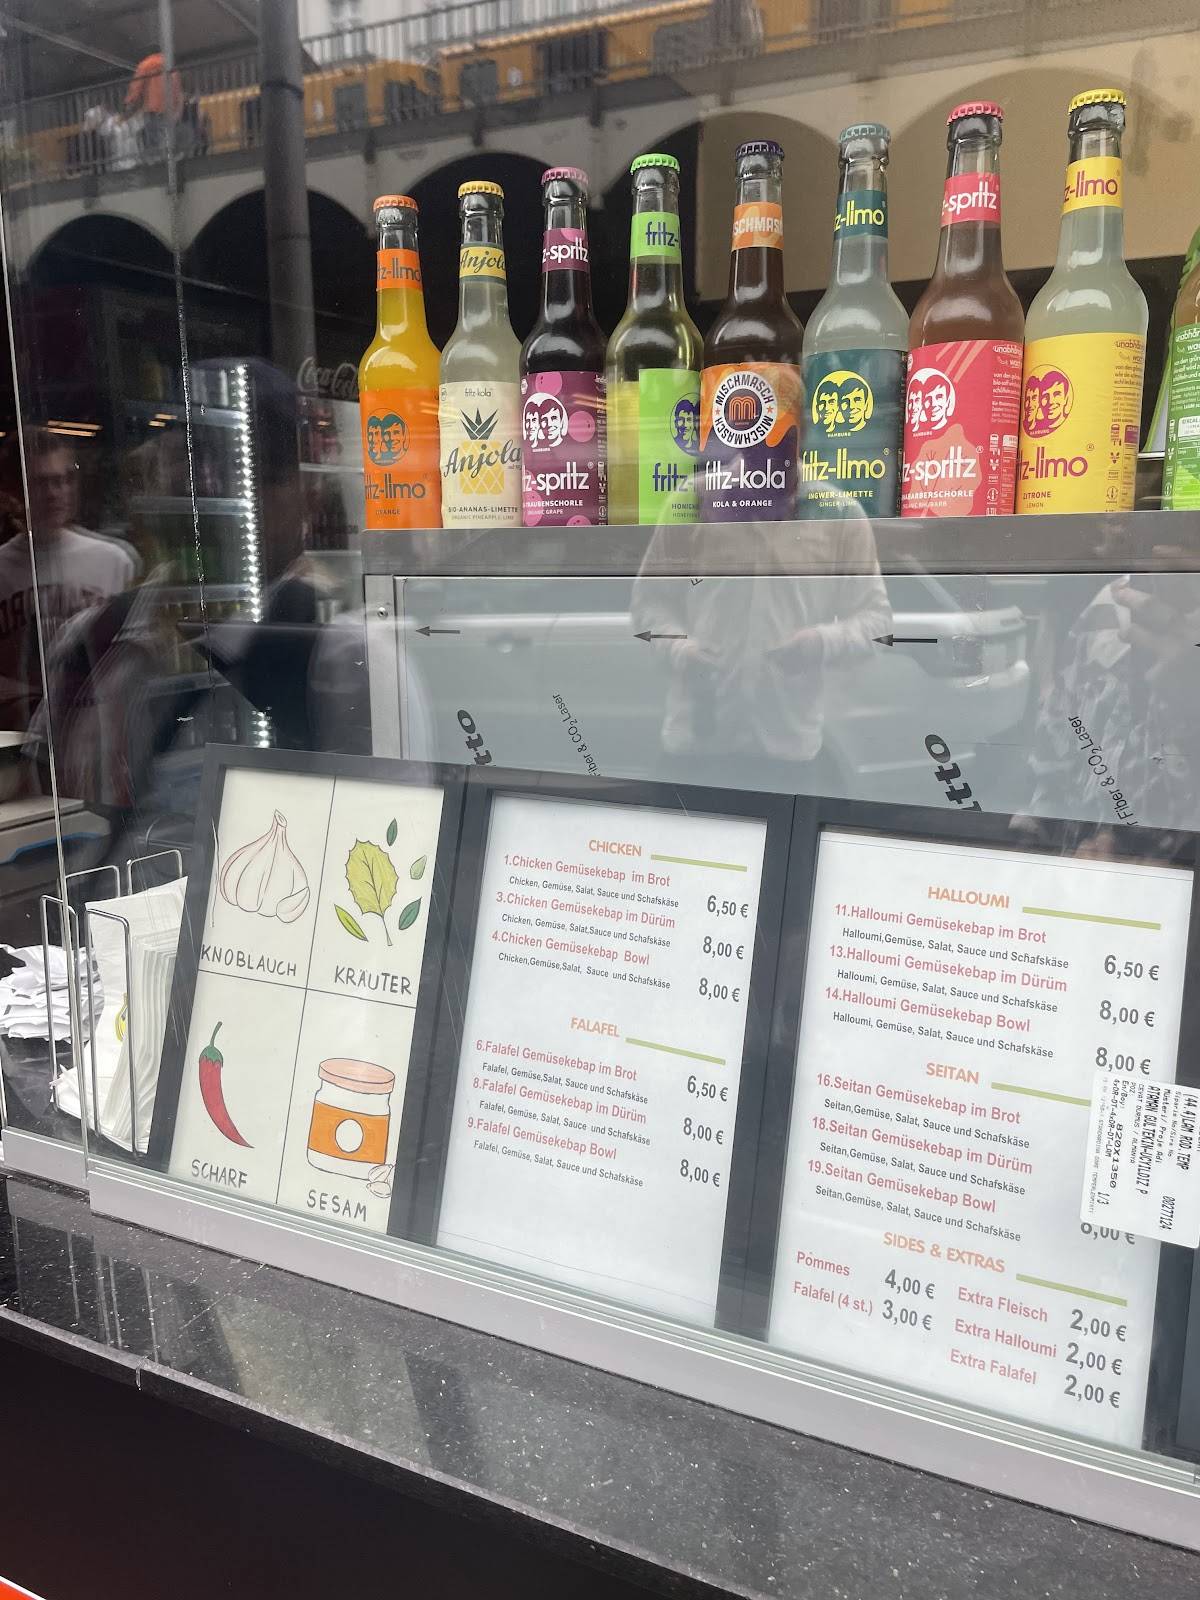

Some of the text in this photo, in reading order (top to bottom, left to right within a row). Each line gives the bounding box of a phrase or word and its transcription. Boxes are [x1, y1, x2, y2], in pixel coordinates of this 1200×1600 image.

[715, 372, 775, 407] MISCHMASCH
[715, 415, 774, 445] MISCHMASCH
[444, 439, 521, 478] Anjola
[705, 459, 786, 491] fritz-kola
[713, 500, 730, 508] KOLA
[740, 500, 772, 508] ORANGE
[808, 490, 873, 500] INGWER-LIMETTE
[552, 692, 574, 720] Laser
[457, 709, 496, 766] tto
[1068, 715, 1095, 750] Laser
[1108, 787, 1135, 820] Fiber
[589, 840, 642, 857] CHICKEN
[505, 855, 670, 887] 1.Chicken Gemüsekebap im Brot
[496, 892, 675, 928] 3.Chicken Gemüsekebap im Dürüm
[597, 888, 619, 899] Sauce
[621, 893, 635, 901] und
[637, 894, 679, 908] Schafskäse
[707, 895, 749, 918] 6,50 €
[928, 887, 1010, 909] HALLOUMI
[836, 904, 1046, 944] 11.Halloumi Gemüsekebap im Brot
[201, 944, 297, 977] KNOBLAUCH
[492, 930, 650, 965] 4.Chicken Gemüsekebap Bowl
[703, 936, 744, 960] 8,00 €
[334, 965, 412, 995] KRÄUTER
[830, 945, 1067, 992] 13.Halloumi Gemüsekebap im Dürüm
[1104, 955, 1159, 981] 6,50 €
[699, 978, 740, 1002] 8,00 €
[826, 987, 1030, 1032] 14.Halloumi Gemüsekebap Bowl
[1100, 1000, 1155, 1027] 8,00 €
[571, 1017, 620, 1037] FALAFEL
[477, 1040, 637, 1081] 6.Falafel Gemüsekebap im Brot
[926, 1063, 979, 1084] SEITAN
[1096, 1047, 1151, 1075] 8,00 €
[473, 1077, 646, 1124] 8.Falafel Gemüsekebap im Dürüm
[687, 1075, 728, 1102] 6,50 €
[818, 1073, 1020, 1124] 16.Seitan Gemüsekebap im Brot
[468, 1117, 617, 1160] 9.Falafel Gemüsekebap Bowl
[683, 1117, 724, 1145] 8,00 €
[813, 1117, 1032, 1174] 18.Seitan Gemüsekebap im Dürüm
[1109, 1123, 1123, 1188] 820X1350
[191, 1159, 248, 1189] SCHARF
[680, 1159, 720, 1187] 8,00 €
[808, 1160, 996, 1212] 19.Seitan Gemüsekebap Bowl
[306, 1189, 368, 1222] SESAM
[1097, 1192, 1109, 1204] 1/3
[797, 1251, 850, 1276] Pommes
[884, 1232, 1005, 1273] SIDES & EXTRAS
[794, 1281, 834, 1303] Falafel
[885, 1269, 935, 1299] 4,00 €
[882, 1299, 932, 1331] 3,00 €
[958, 1287, 1047, 1322] Extra Fleisch
[955, 1319, 1057, 1358] Extra Halloumi
[1070, 1309, 1127, 1342] 2,00 €
[951, 1349, 1037, 1385] Extra Falafel
[1066, 1342, 1122, 1376] 2,00 €
[1064, 1375, 1120, 1408] 2,00 €
